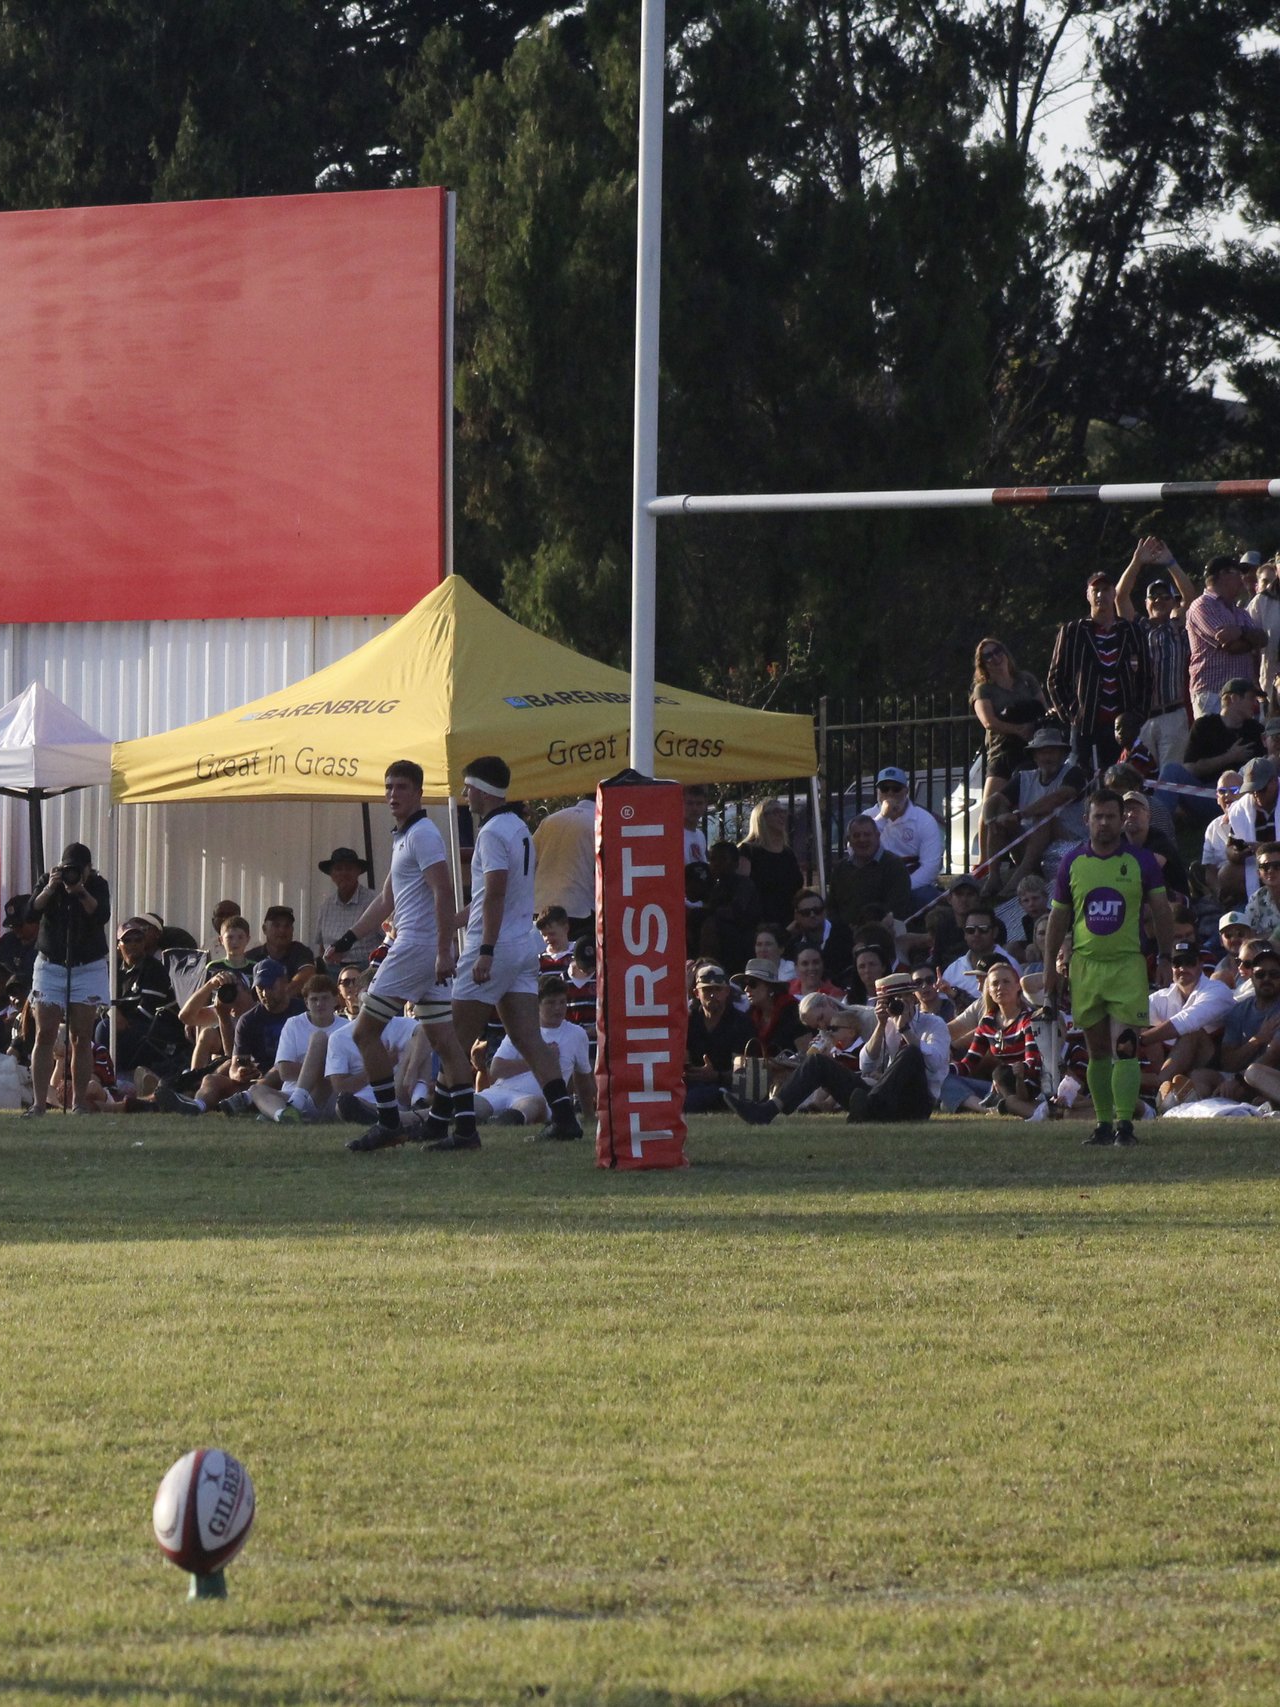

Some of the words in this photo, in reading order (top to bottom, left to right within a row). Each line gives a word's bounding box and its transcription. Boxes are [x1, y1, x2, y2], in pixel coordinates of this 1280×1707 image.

[256, 699, 401, 720] BARENBRUG
[547, 734, 617, 766] Great
[654, 730, 725, 758] Grass
[196, 751, 259, 780] Great
[267, 747, 286, 775] in
[294, 747, 359, 778] Grass
[1088, 900, 1123, 916] OUT
